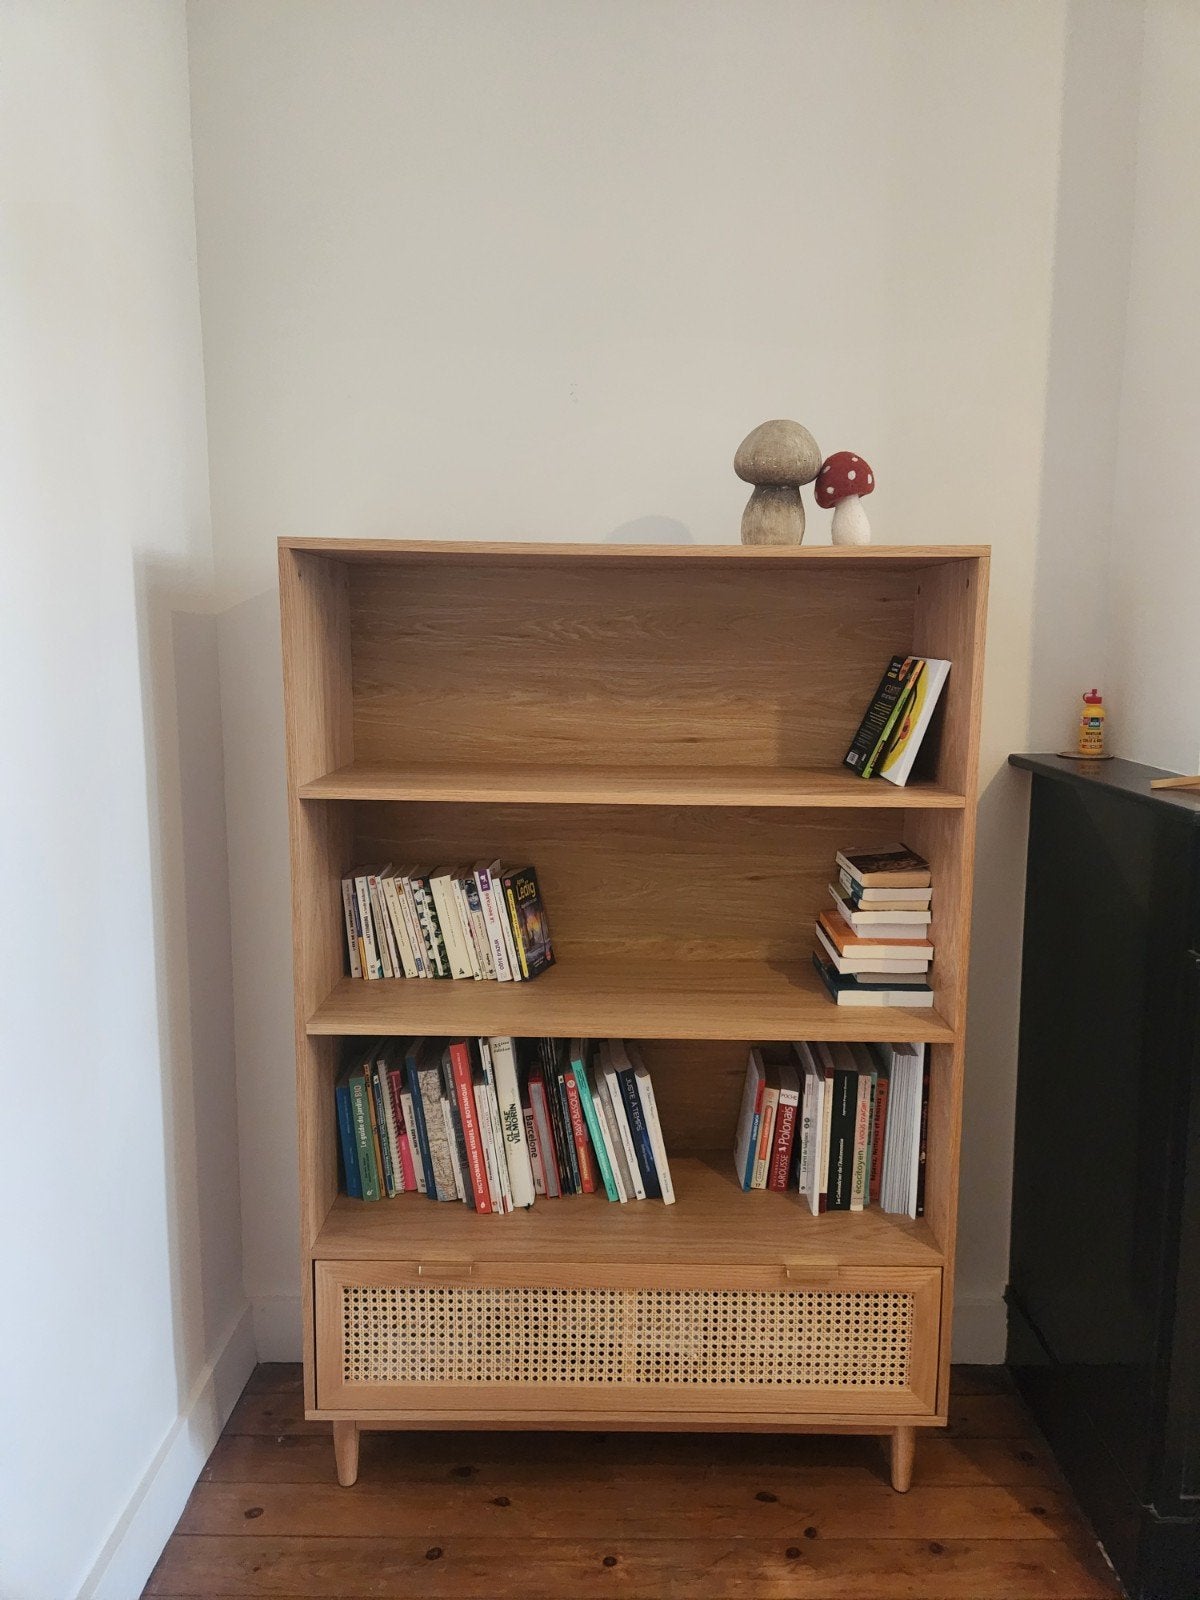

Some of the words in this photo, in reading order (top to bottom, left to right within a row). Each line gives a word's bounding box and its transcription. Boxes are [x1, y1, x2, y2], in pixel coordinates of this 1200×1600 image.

[355, 1098, 363, 1116] jardin
[461, 1084, 471, 1118] BOTANIQUE
[568, 1090, 580, 1119] BASQUE
[626, 1078, 635, 1099] JUSTE
[632, 1107, 642, 1131] TEMPS
[357, 1116, 364, 1124] du
[358, 1124, 367, 1139] guide
[504, 1111, 514, 1142] CLAUSE
[510, 1103, 520, 1144] VILMORIN
[573, 1120, 583, 1136] PAYS
[778, 1106, 793, 1145] Polonais
[526, 1115, 537, 1158] Barcelone
[472, 1151, 483, 1194] DICTIONNAIRE
[778, 1155, 788, 1187] LAROUSSE
